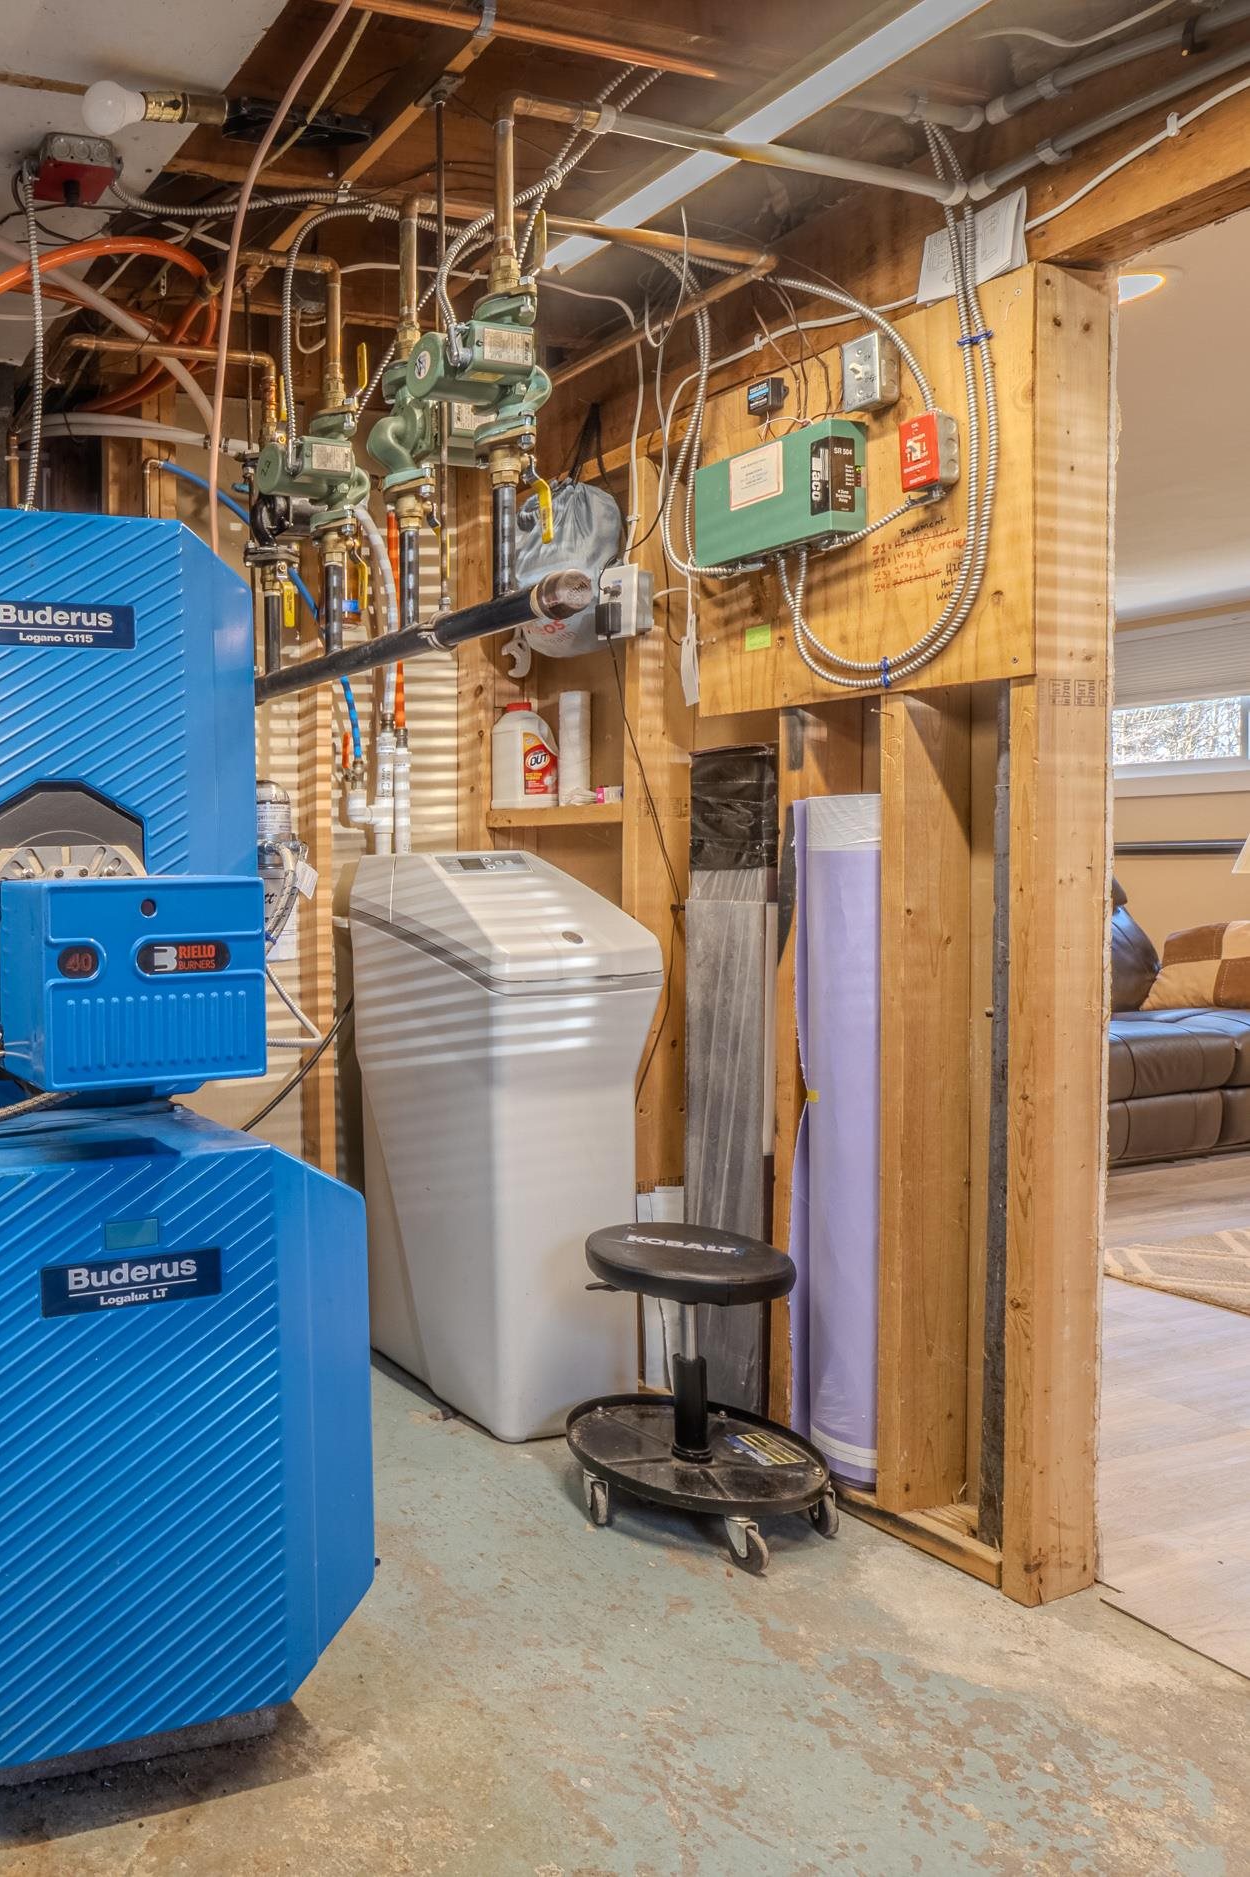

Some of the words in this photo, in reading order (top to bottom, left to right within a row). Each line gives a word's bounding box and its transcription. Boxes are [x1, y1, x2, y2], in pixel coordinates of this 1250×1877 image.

[19, 632, 62, 643] Logano
[64, 633, 94, 644] G115
[529, 753, 549, 767] OUT
[178, 944, 216, 959] RIELLO
[66, 952, 93, 972] 40
[178, 959, 216, 971] BURNERS
[626, 1234, 737, 1254] KOBALT
[67, 1258, 198, 1291] Buderus
[100, 1292, 150, 1306] Logalux
[152, 1288, 168, 1299] LT
